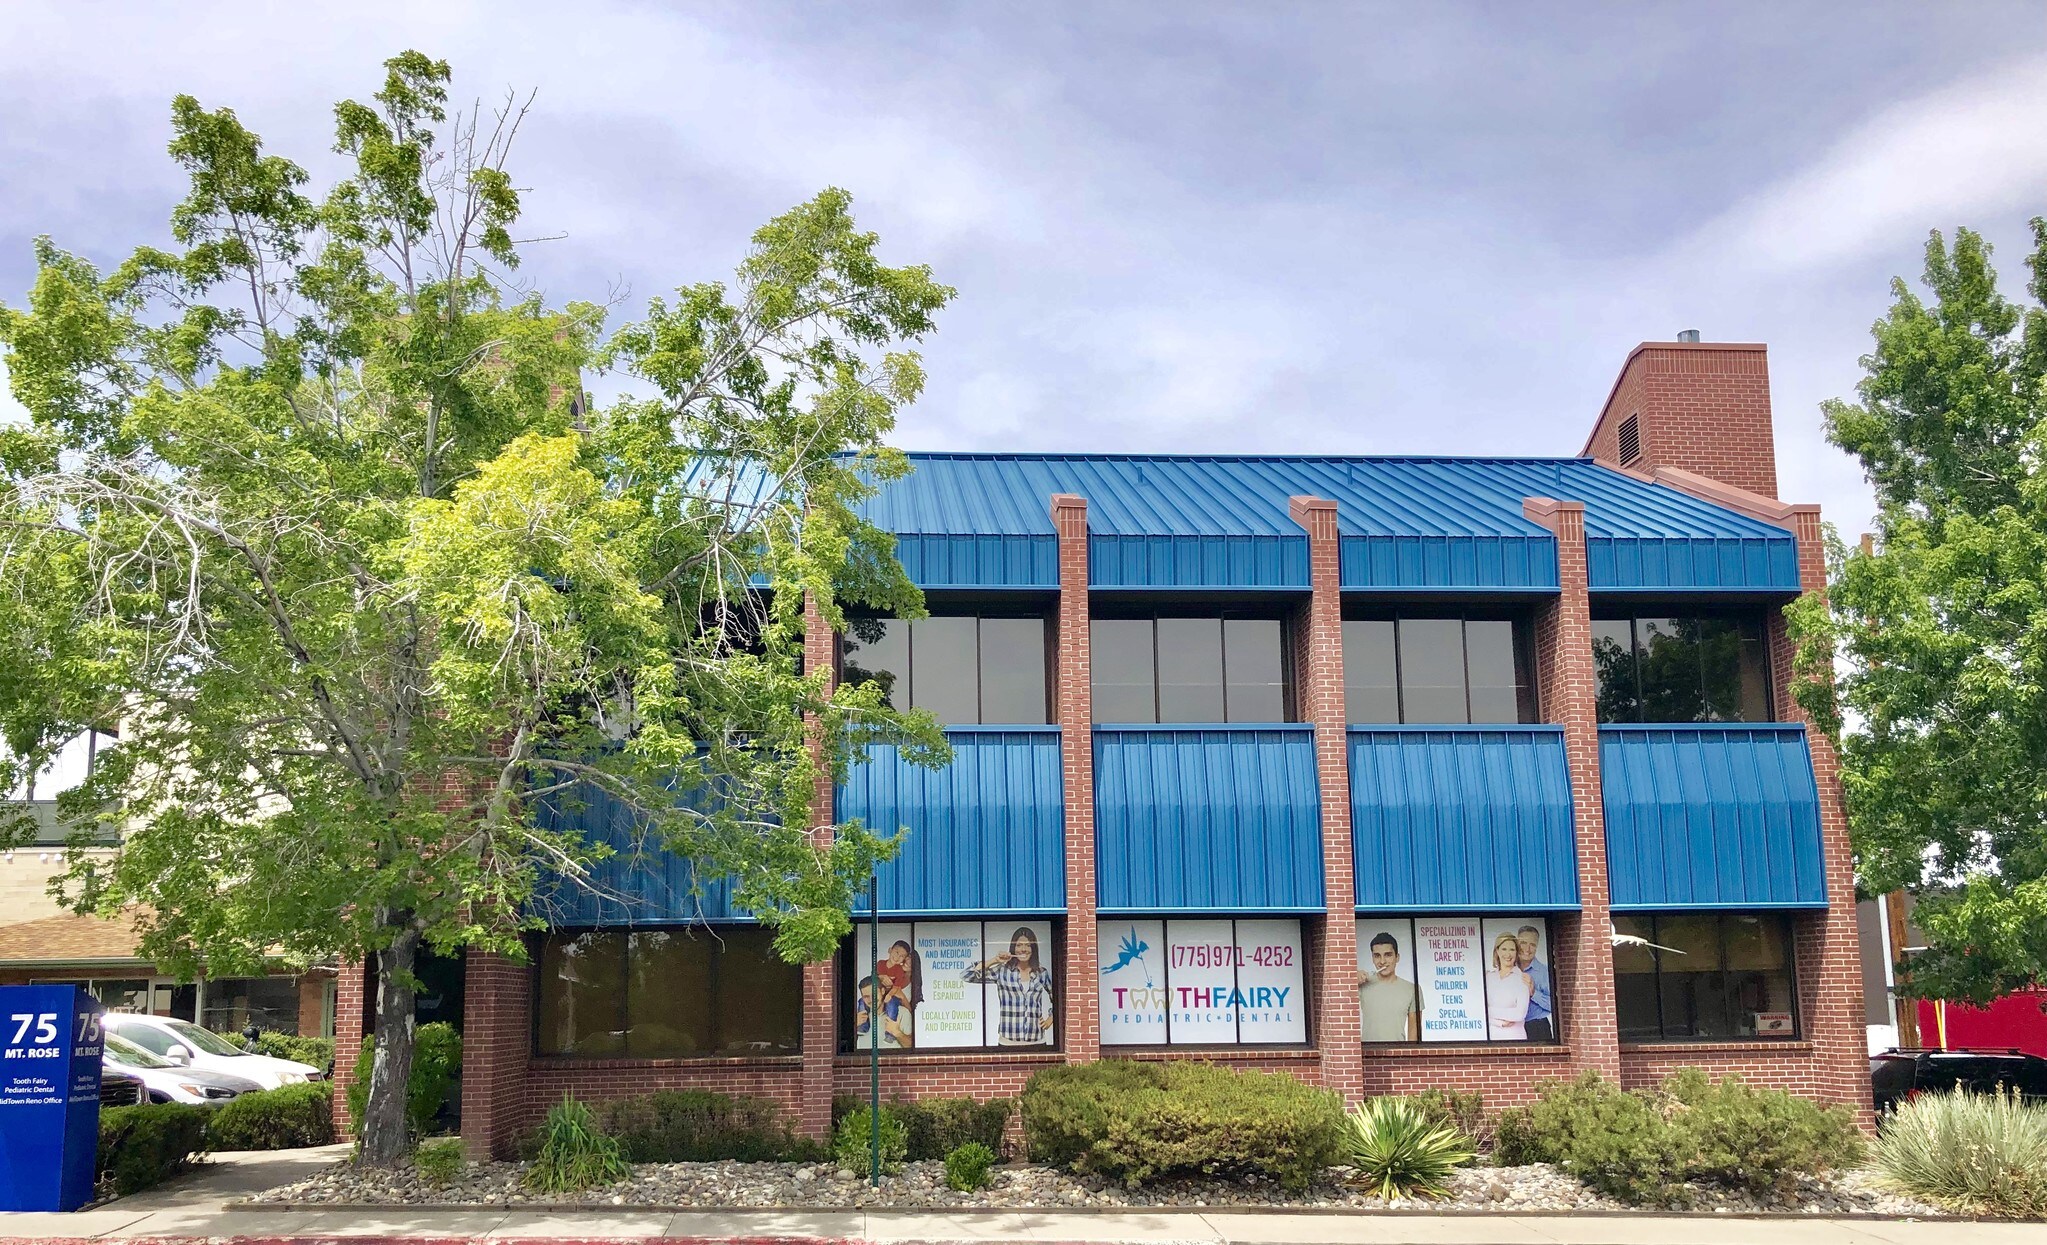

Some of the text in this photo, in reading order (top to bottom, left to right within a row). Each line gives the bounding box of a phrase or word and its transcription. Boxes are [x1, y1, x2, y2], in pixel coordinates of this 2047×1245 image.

[1420, 926, 1476, 937] SPECIALIZING IN
[918, 937, 979, 948] MOST INSURANCES
[1428, 939, 1469, 949] THE DENTAL
[925, 949, 972, 959] AND MEDICAID
[1171, 943, 1293, 969] (775)971-4252
[1433, 951, 1465, 962] CARE OF:
[932, 960, 965, 970] ACCEPTED
[1435, 966, 1465, 976] INFANTS
[932, 979, 965, 989] SE HABLA
[1434, 979, 1468, 990] CHILDREN
[1441, 994, 1463, 1005] TEENS
[921, 1010, 976, 1021] LOCALLY OWNED
[1438, 1008, 1468, 1019] SPECIAL
[11, 1013, 58, 1044] 75
[78, 1012, 100, 1043] 75
[924, 1021, 973, 1032] AND OPERATED
[1425, 1019, 1483, 1030] NEEDS PATIENTS
[4, 1047, 60, 1059] MT. ROSE
[84, 1046, 100, 1056] ROSE
[13, 1077, 49, 1086] Tooth Fairy
[4, 1086, 32, 1094] Pediatric
